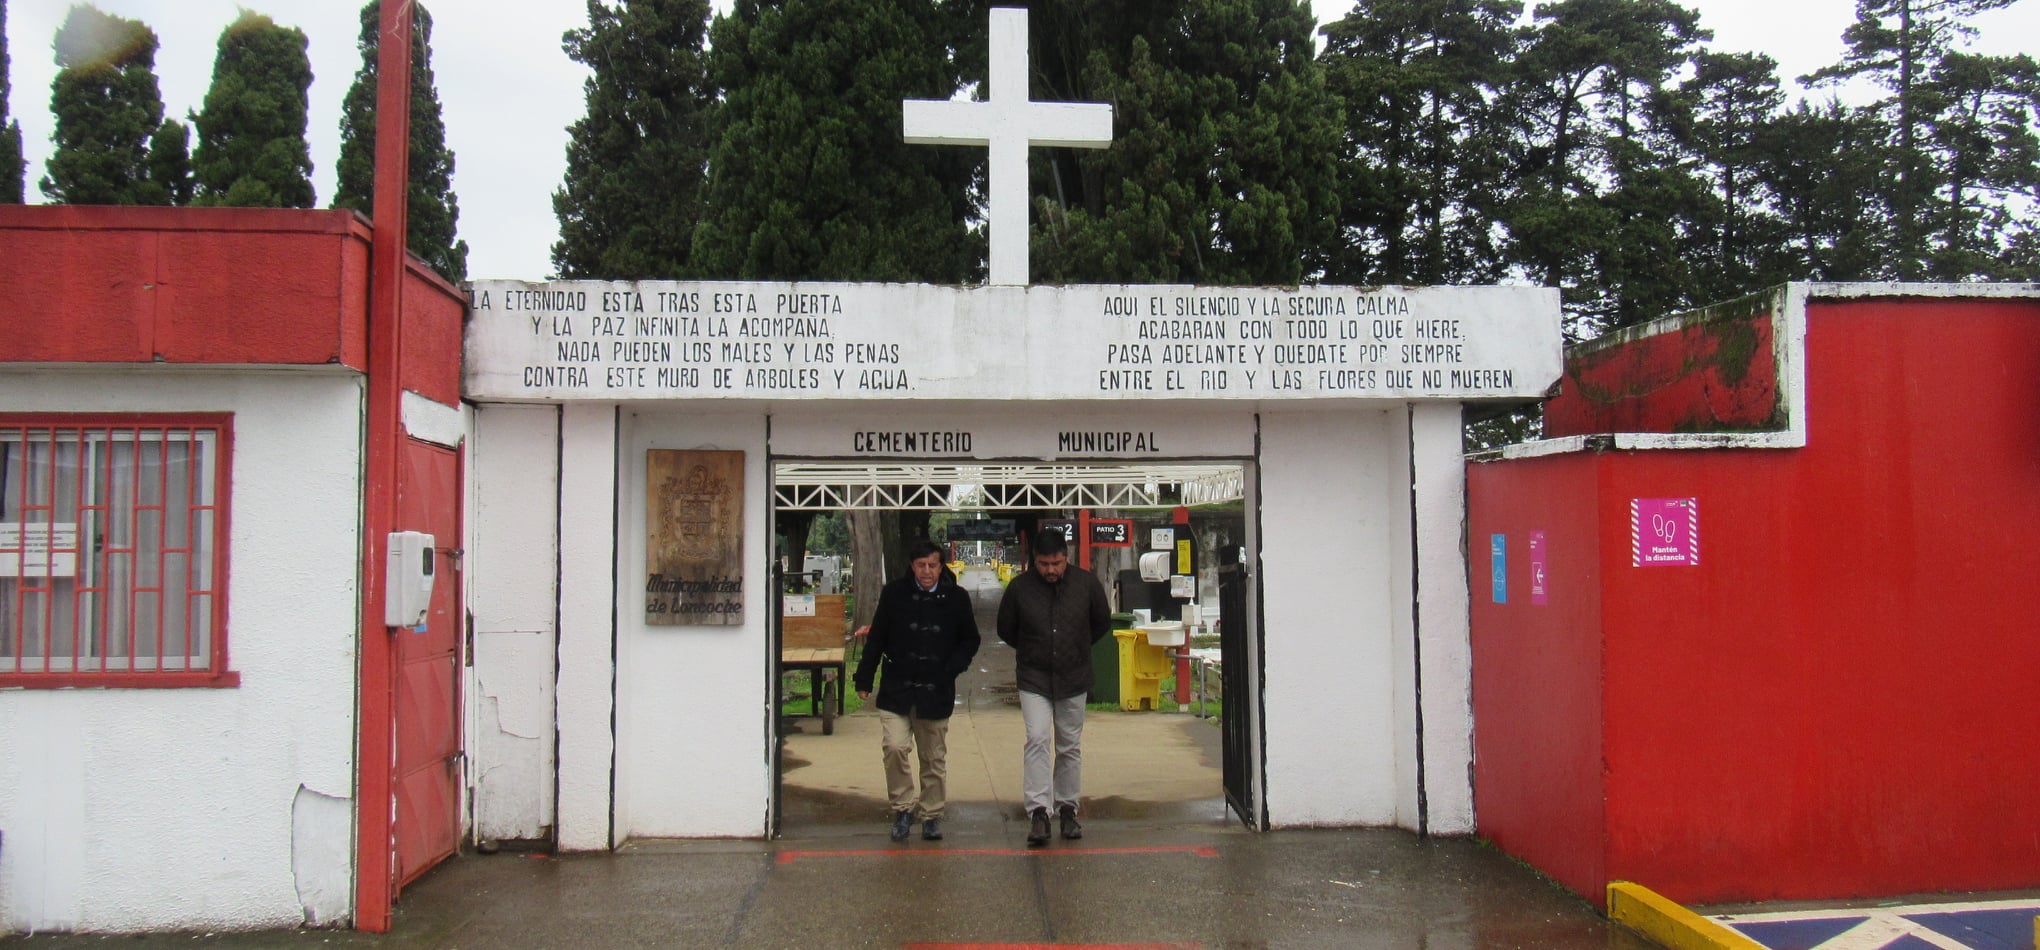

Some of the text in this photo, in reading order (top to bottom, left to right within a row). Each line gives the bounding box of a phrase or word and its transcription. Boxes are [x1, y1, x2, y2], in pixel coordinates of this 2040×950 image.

[472, 290, 842, 314] LA ETERNIDAD ESTA TRAS ESTA PUERTA
[1151, 296, 1167, 316] EL
[1176, 296, 1239, 316] SILENCIO
[1248, 297, 1256, 316] Y
[1263, 296, 1280, 316] LA
[1289, 296, 1346, 316] SEGURA
[1357, 296, 1409, 316] CALMA
[532, 316, 542, 336] Y
[553, 316, 572, 337] LA
[592, 316, 625, 337] PAZ
[636, 316, 699, 337] INFINITA
[708, 317, 728, 338] LA
[1139, 320, 1225, 340] ACABARAN
[1240, 320, 1272, 340] CON
[1286, 320, 1327, 340] TODO
[1341, 319, 1357, 340] LO
[1373, 319, 1404, 342] QUE
[558, 341, 899, 364] NADA PUEDEN LOS MALES Y LAS PENAS
[1108, 344, 1152, 364] PASA
[1163, 344, 1246, 364] ADELANTE
[1254, 345, 1265, 364] Y
[1274, 344, 1347, 366] QUEDATE
[1402, 344, 1463, 364] SIEMPRE
[524, 366, 916, 391] CONTRA ESTE MURO DE ARBOLES Y AGUA.
[1100, 370, 1152, 390] ENTRE
[1167, 370, 1184, 390] EL
[1202, 370, 1226, 390] RIO
[1245, 370, 1256, 390] Y
[1272, 370, 1302, 390] LAS
[1319, 370, 1376, 390] FLORES
[1423, 370, 1441, 389] NO
[854, 431, 1159, 452] CEMENTERIO MUNICIPAL
[1065, 523, 1073, 535] 2
[1117, 524, 1125, 535] 3
[647, 574, 742, 596] Municipalidad
[647, 599, 667, 613] de
